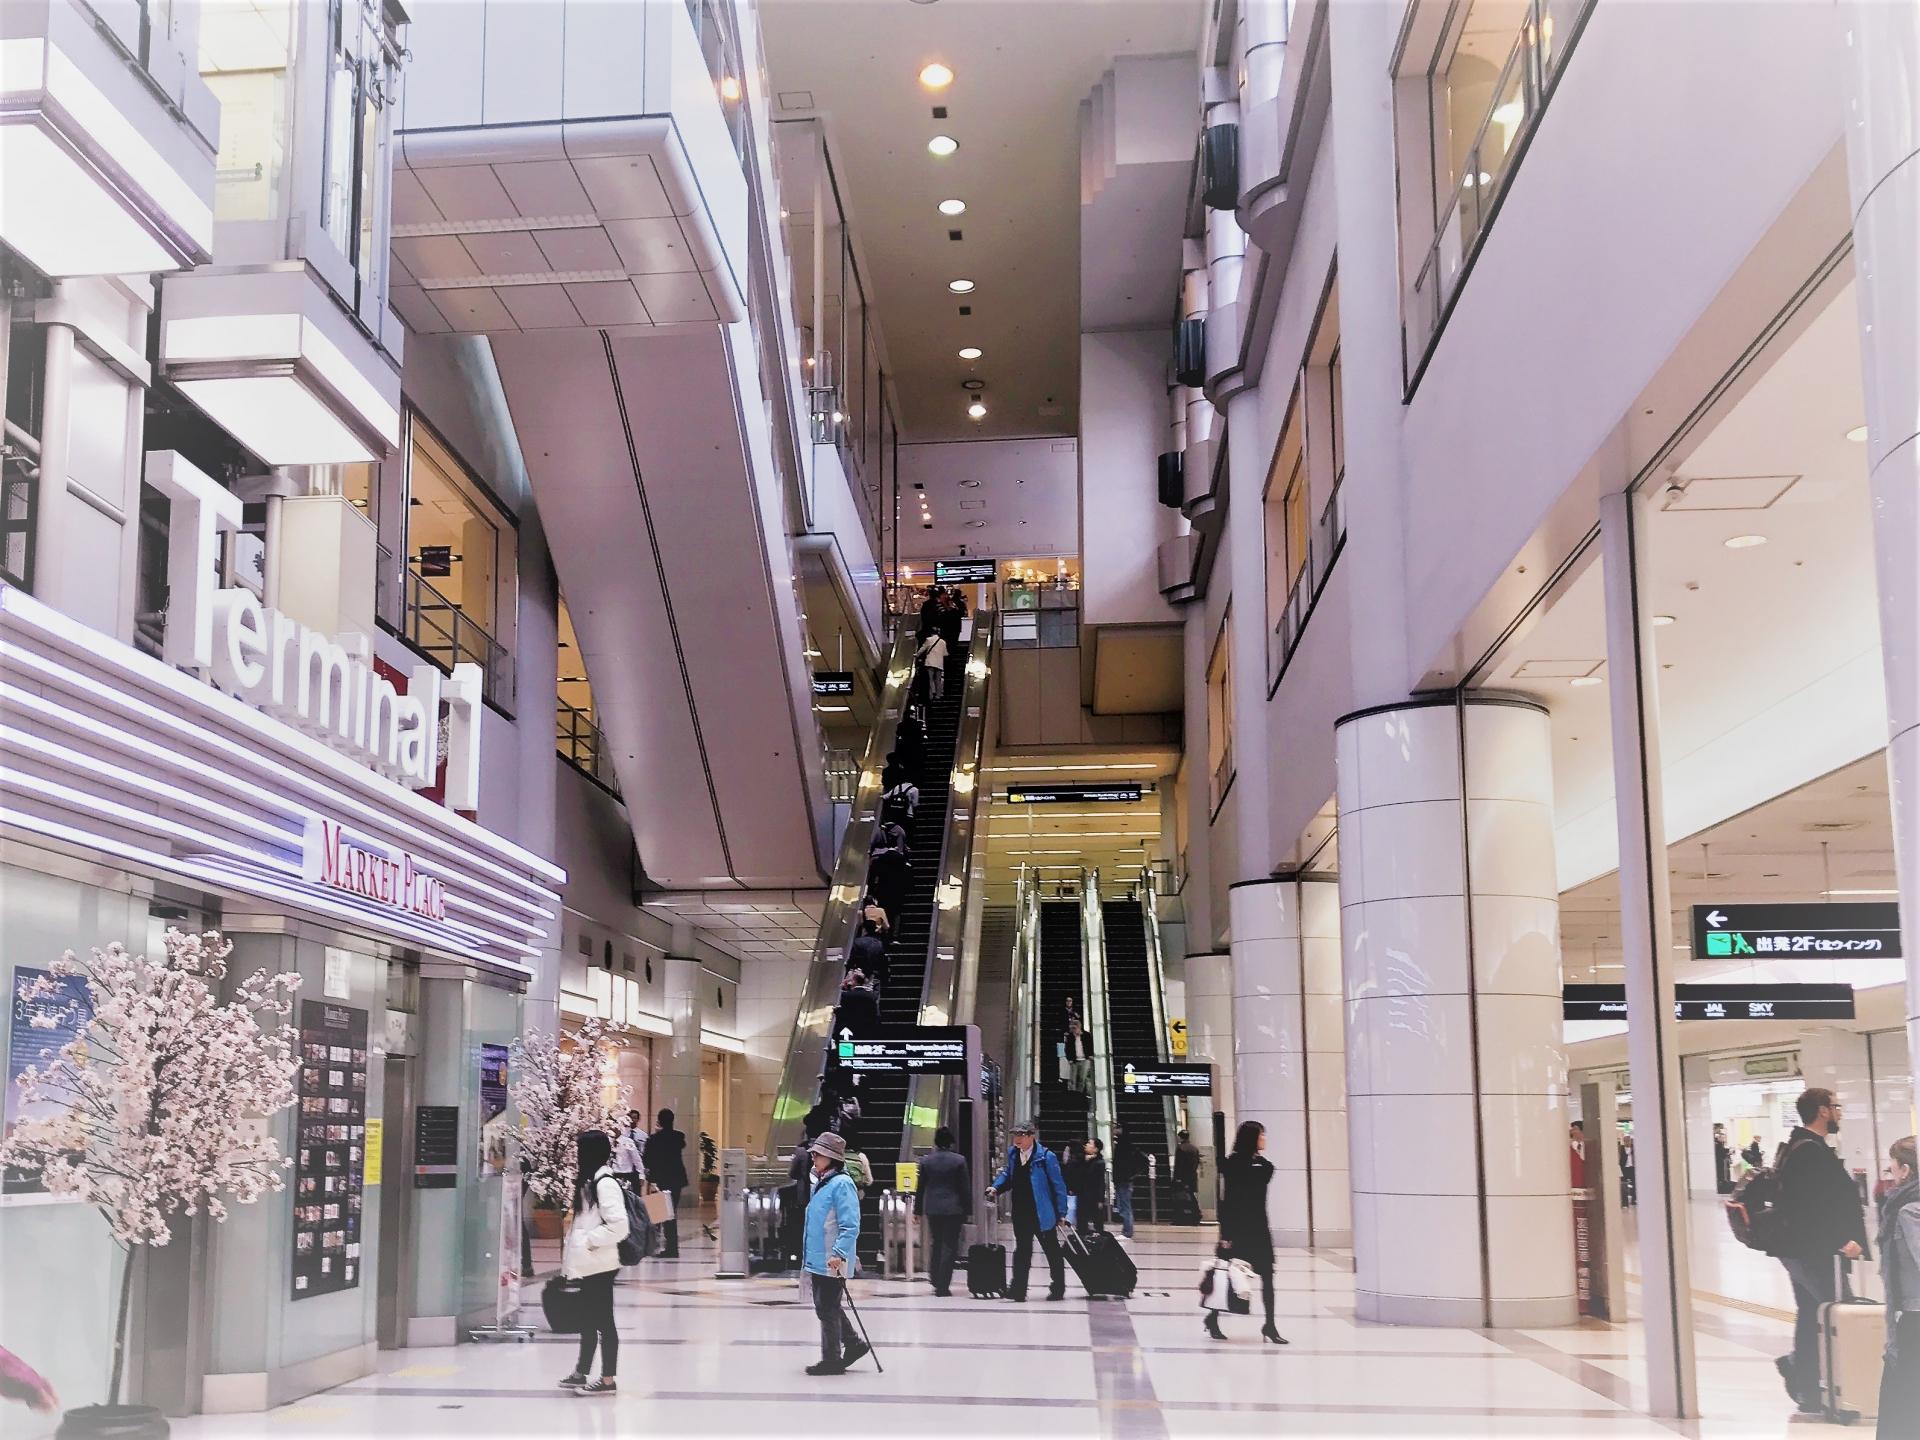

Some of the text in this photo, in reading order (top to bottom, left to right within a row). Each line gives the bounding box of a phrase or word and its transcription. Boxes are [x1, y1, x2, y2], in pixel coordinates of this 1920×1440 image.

[146, 449, 441, 788] Terminal
[320, 819, 446, 921] MARKET PLACE
[1704, 1002, 1774, 1012] JAL SKY
